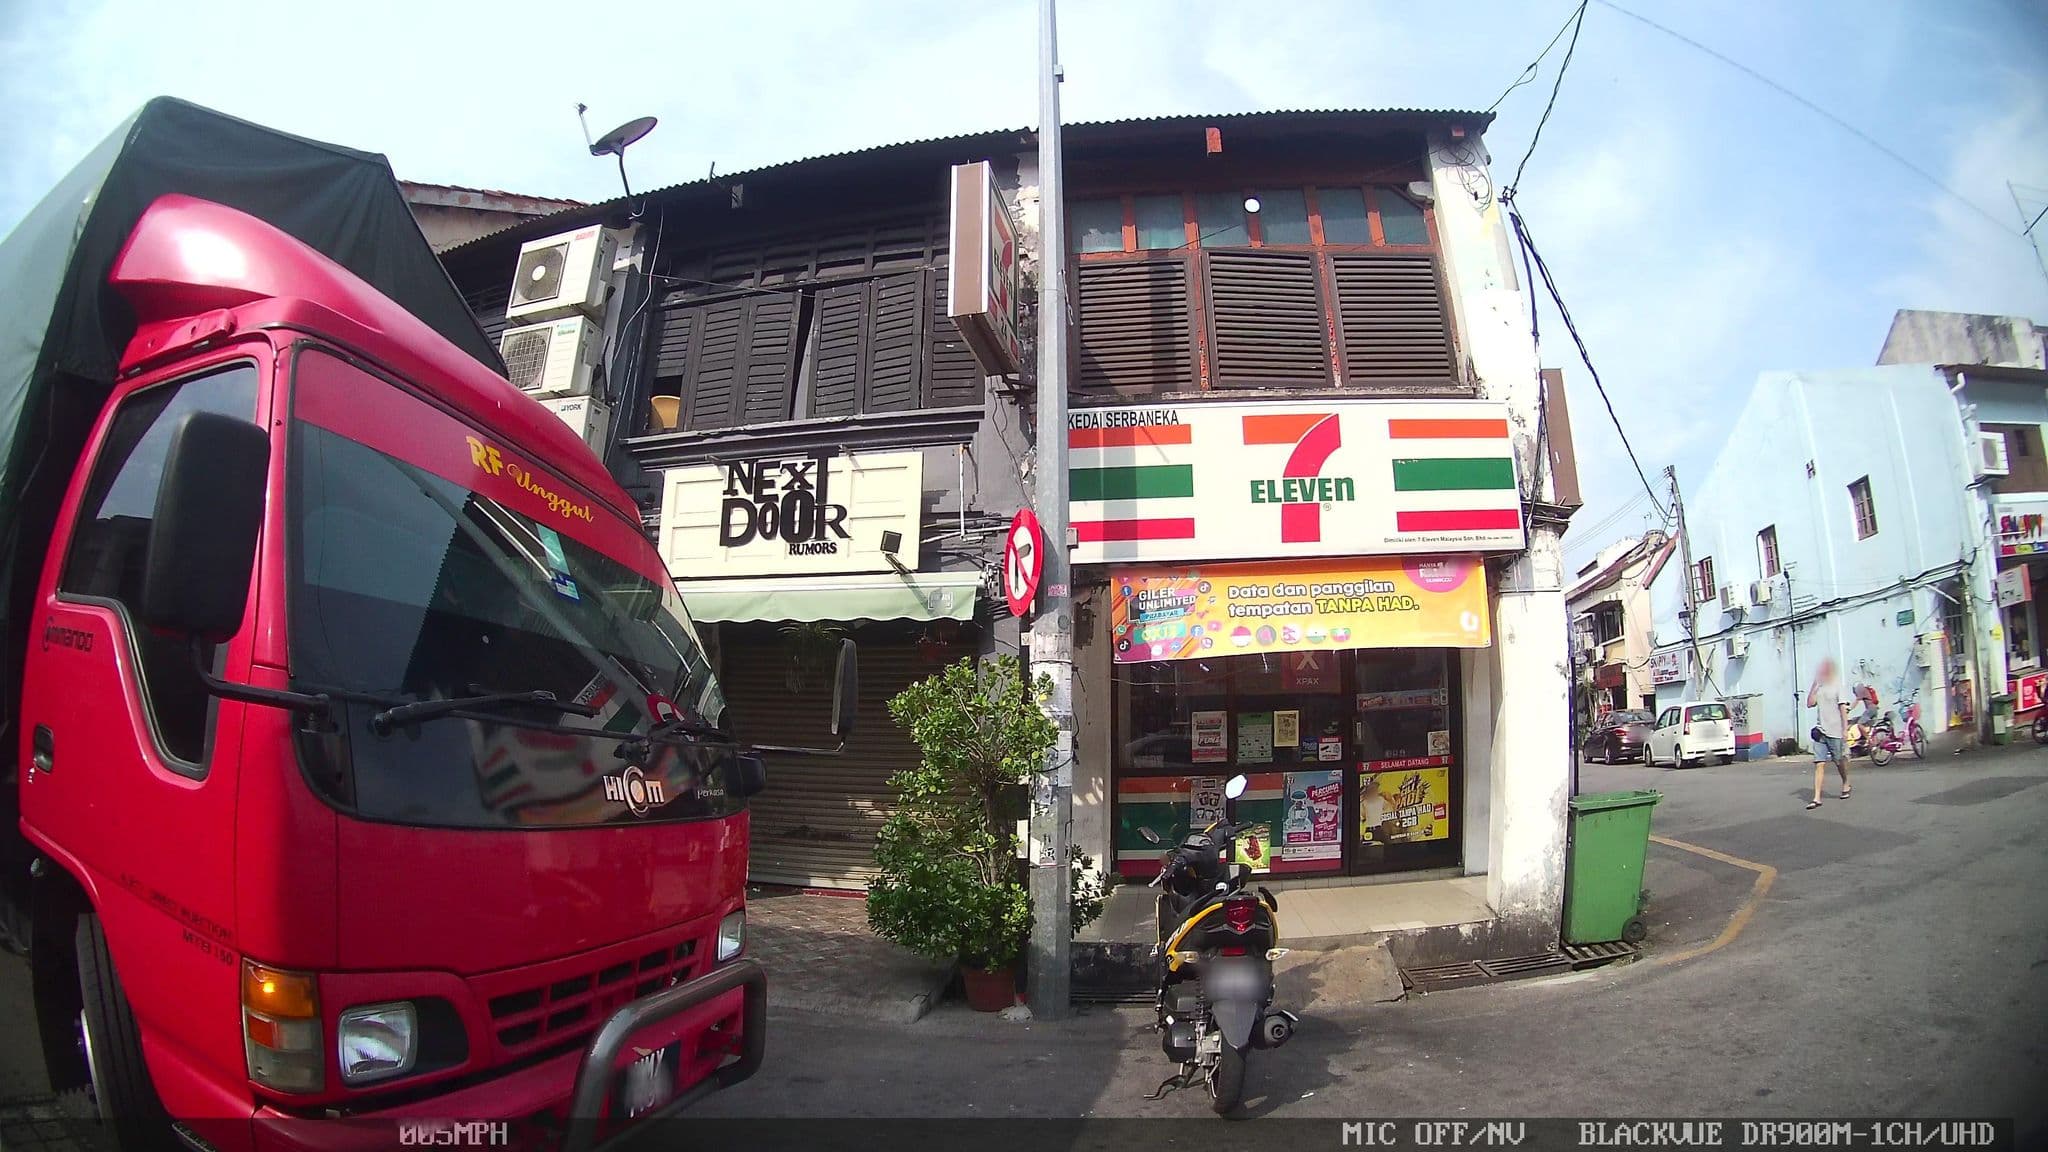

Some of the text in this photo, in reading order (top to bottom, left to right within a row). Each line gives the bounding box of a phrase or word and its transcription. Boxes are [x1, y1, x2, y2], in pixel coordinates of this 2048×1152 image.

[1068, 410, 1179, 429] KEDAI SERBANEKA
[466, 435, 594, 523] RF Unggul
[722, 450, 839, 503] NEXT
[1242, 413, 1341, 543] 7
[719, 489, 852, 547] DOOR
[788, 542, 838, 556] RUMORS
[1138, 588, 1176, 601] GILER
[1227, 580, 1395, 599] Data dan panggilan
[1138, 596, 1197, 611] UNLIMITED
[1228, 596, 1420, 619] tempatan TANPA HAD.
[1380, 760, 1406, 769] SELAMAT
